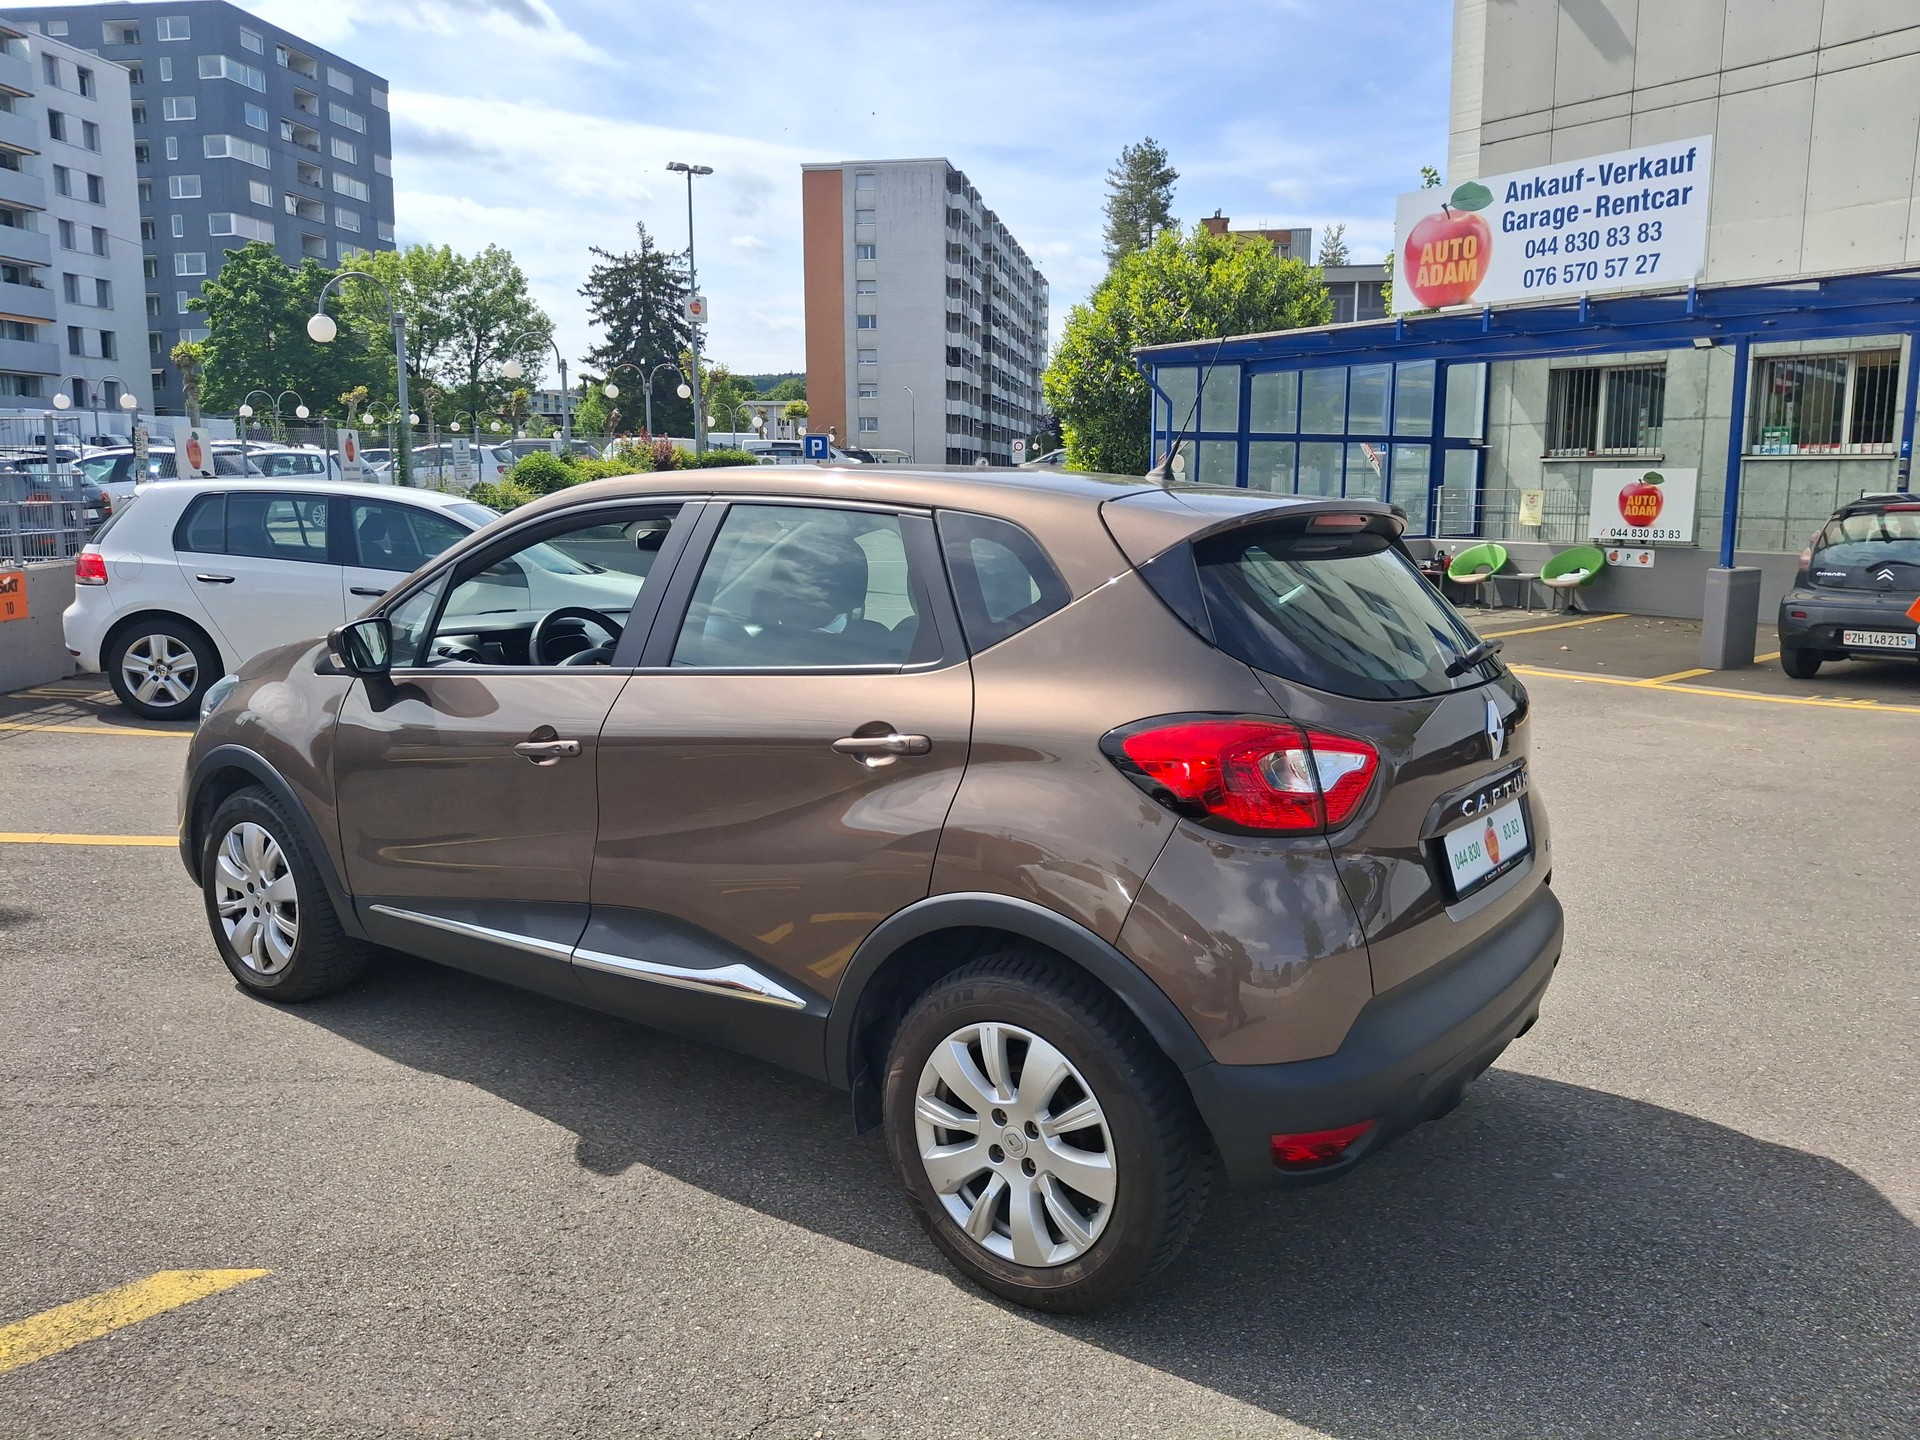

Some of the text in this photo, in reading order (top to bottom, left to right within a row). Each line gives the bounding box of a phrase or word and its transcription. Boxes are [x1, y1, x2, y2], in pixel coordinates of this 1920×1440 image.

[1420, 234, 1478, 265] AUTO
[1524, 220, 1662, 259] 044 830 83 83
[1415, 258, 1477, 289] ADAM
[1523, 252, 1661, 289] 076 570 57 27
[811, 439, 823, 457] P
[1624, 505, 1656, 516] ADAM
[1626, 495, 1657, 506] AUTO
[1610, 528, 1681, 539] 044 830 83 83
[6, 601, 14, 615] 10
[1461, 771, 1528, 817] CAPTUR
[1454, 818, 1520, 870] 044 830 83 83
